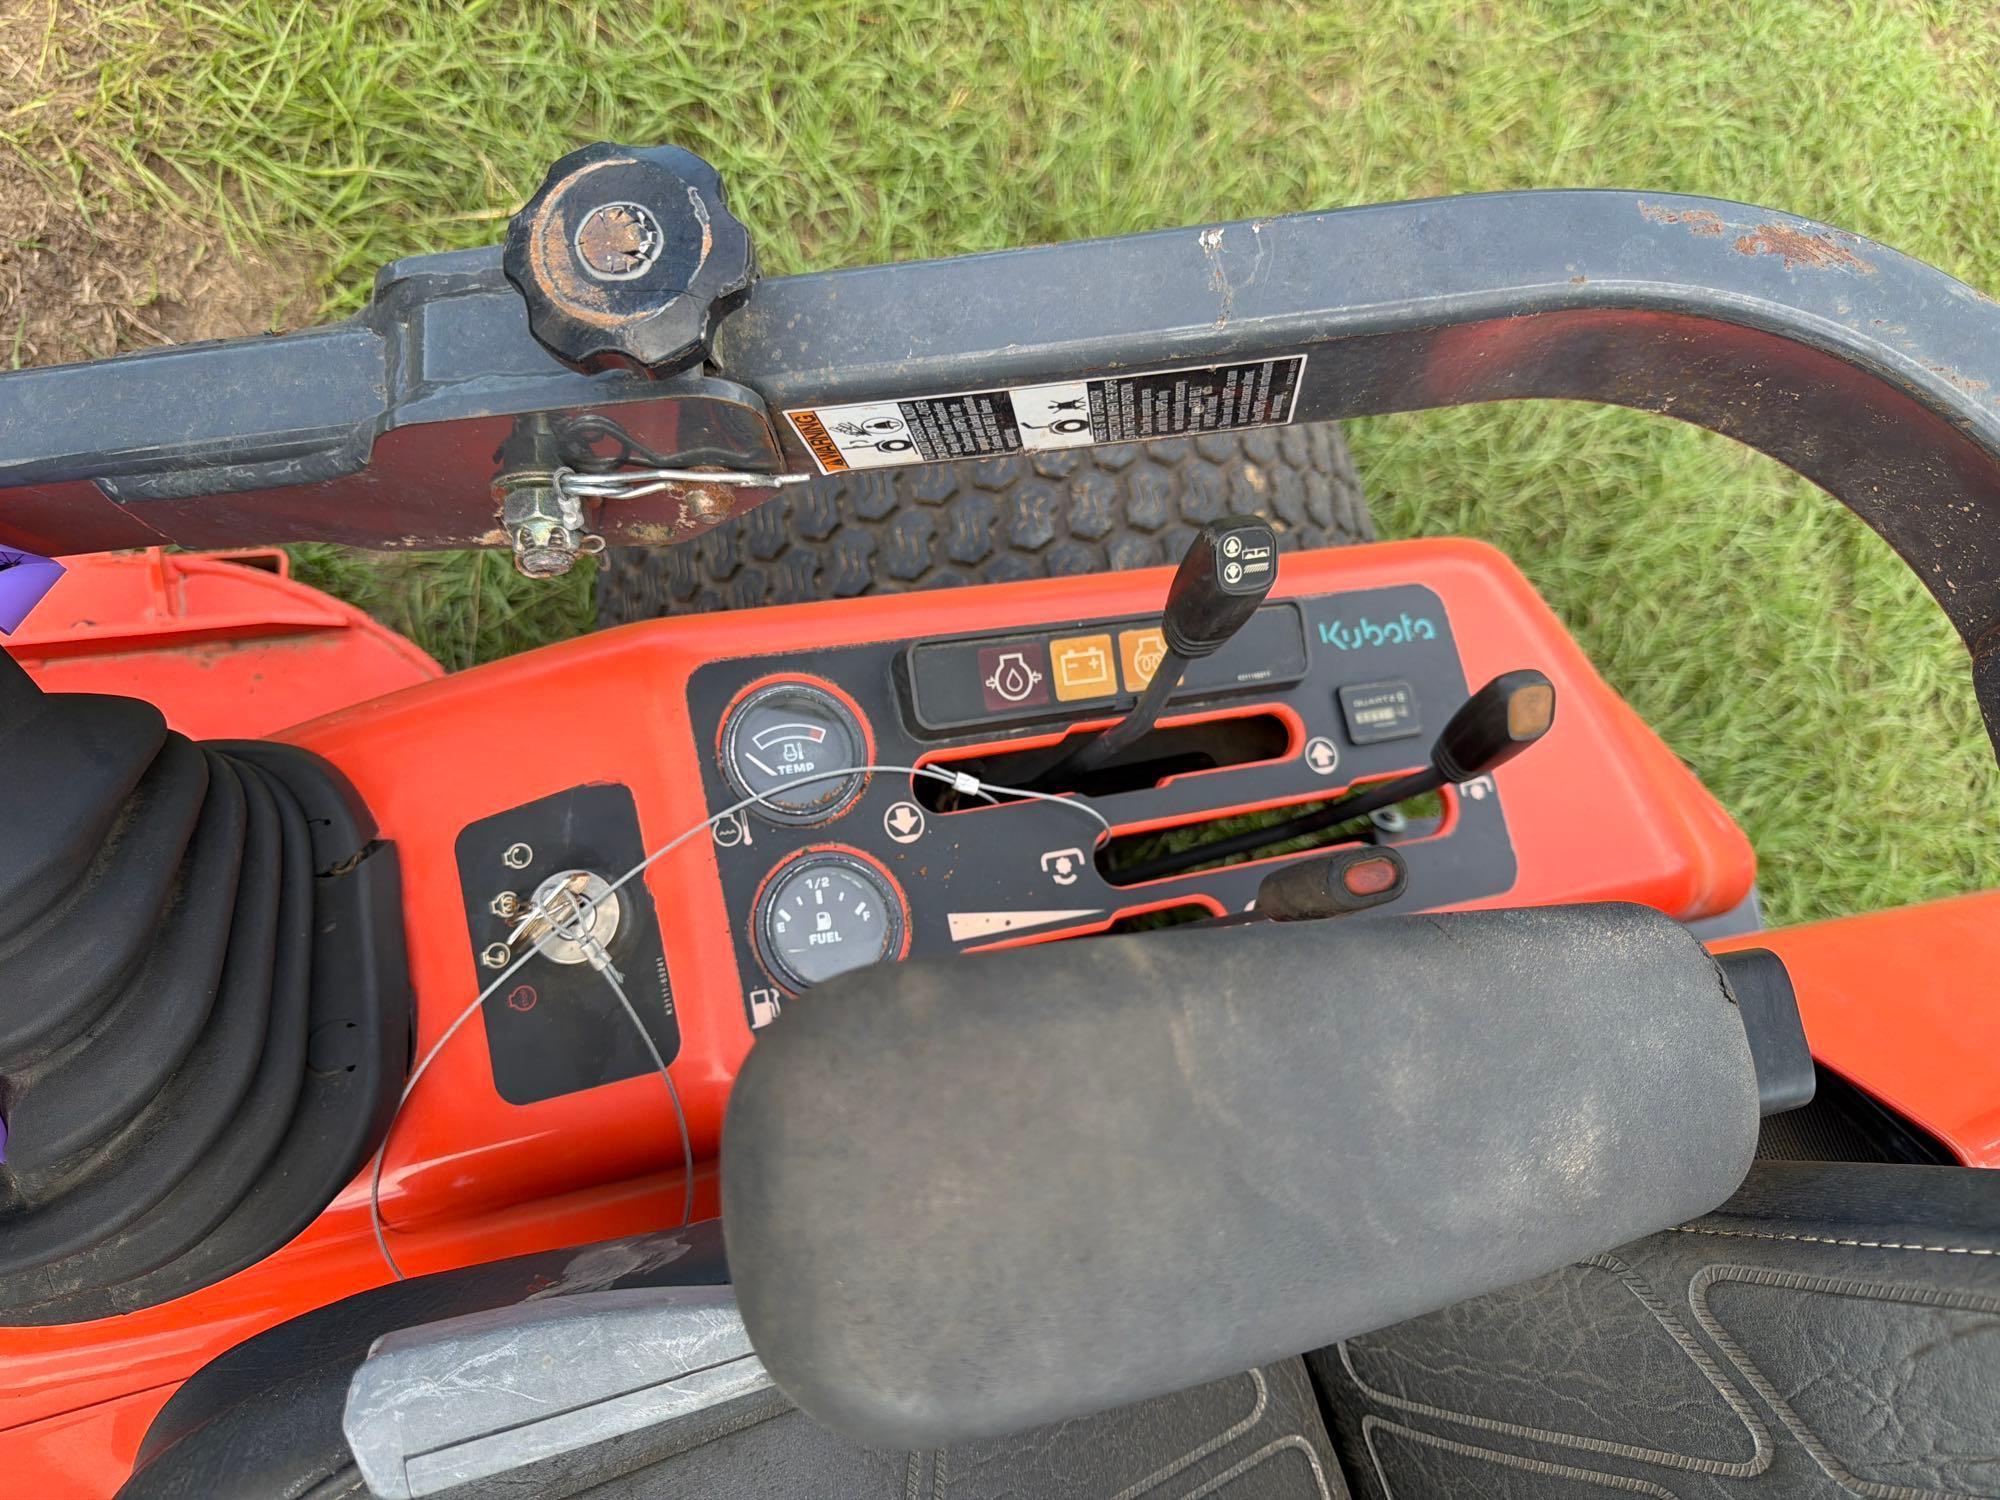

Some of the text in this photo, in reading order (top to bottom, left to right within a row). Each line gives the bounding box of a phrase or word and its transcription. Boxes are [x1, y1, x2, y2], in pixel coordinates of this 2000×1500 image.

[793, 414, 840, 460] WARNING
[1318, 612, 1436, 650] Kubota
[777, 762, 815, 776] TEMP
[805, 876, 830, 890] 1/2
[863, 910, 871, 922] F
[776, 921, 786, 933] E
[808, 931, 842, 945] FUEL
